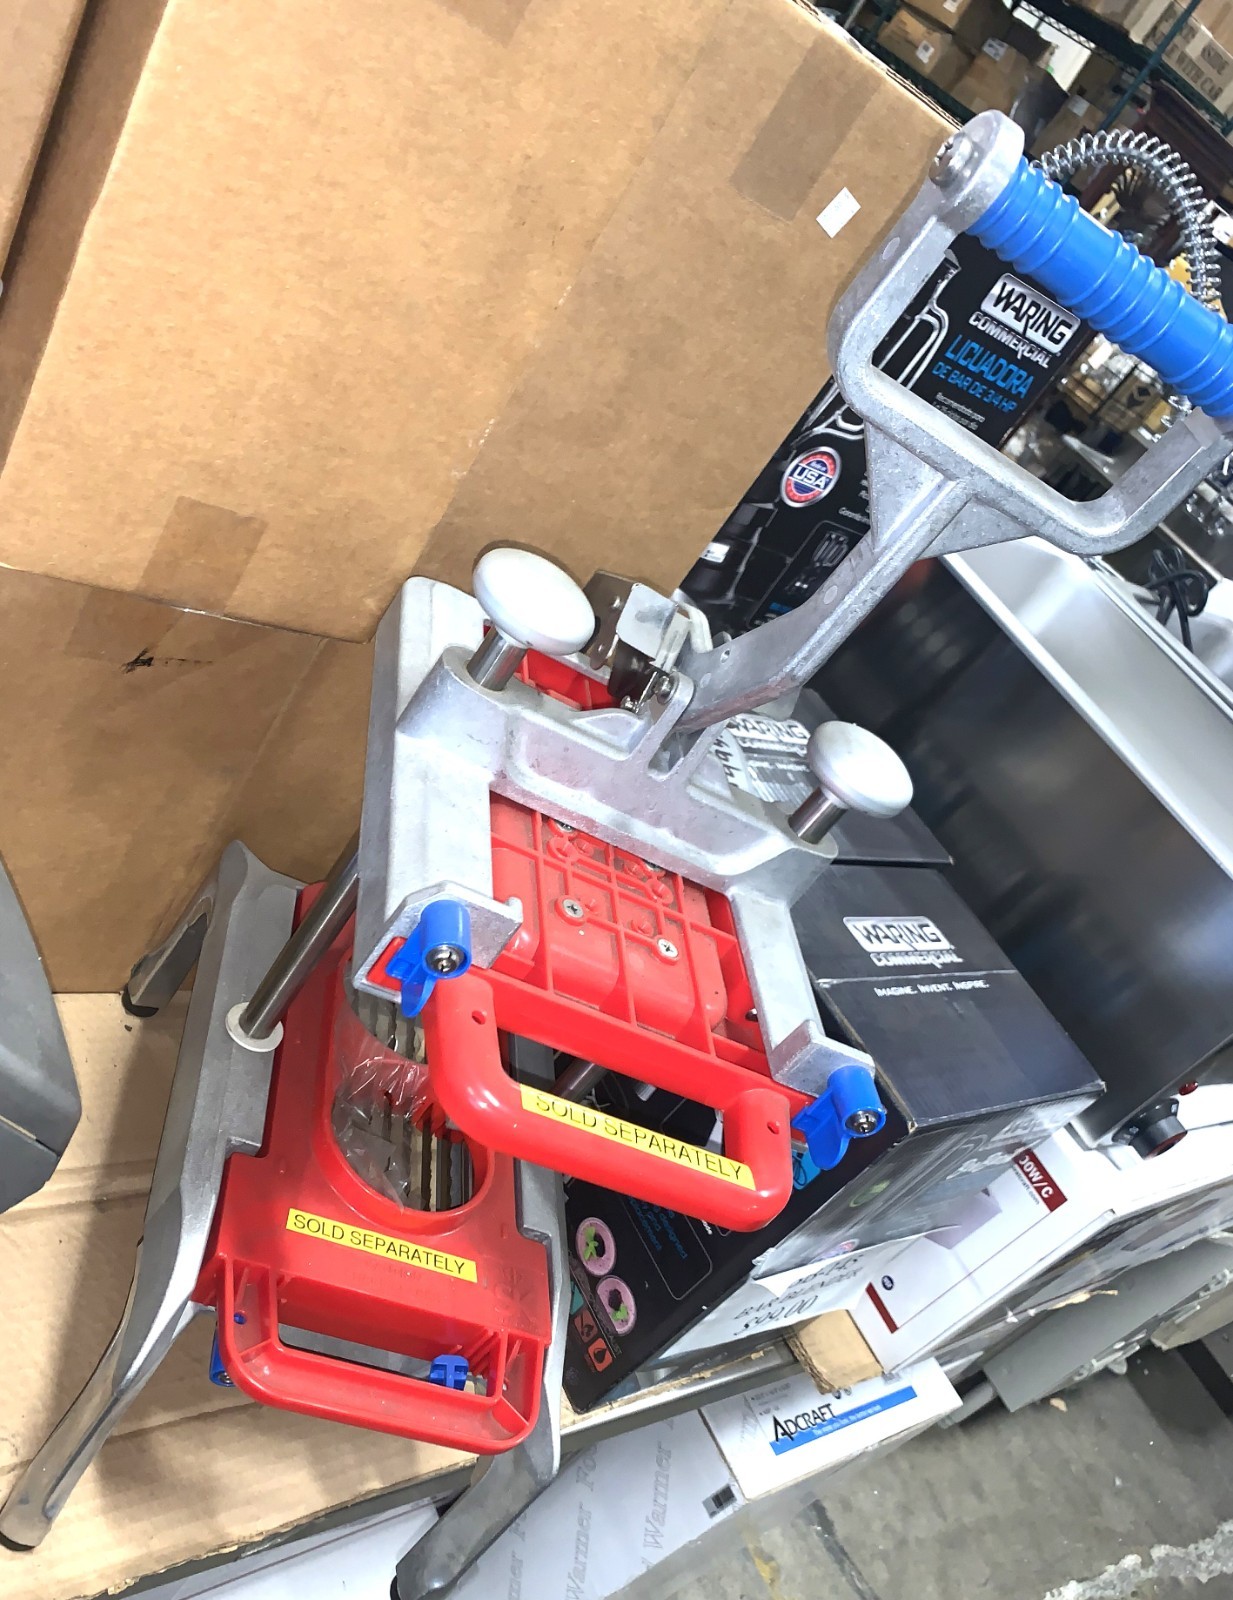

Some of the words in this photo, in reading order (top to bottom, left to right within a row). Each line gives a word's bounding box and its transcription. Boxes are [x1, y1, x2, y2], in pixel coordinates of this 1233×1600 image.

[993, 282, 1073, 346] WARING
[968, 311, 1053, 369] COMMERCIAL
[931, 361, 949, 379] DE
[947, 369, 971, 391] BAR
[968, 381, 988, 398] DE
[944, 334, 1035, 399] LICUADORA
[793, 465, 828, 490] USA
[853, 923, 942, 951] WARING
[870, 950, 964, 969] COMMERCIAL
[536, 1094, 597, 1128] SOLD
[604, 1117, 742, 1180] SEPARATELY
[293, 1213, 345, 1240] SOLD
[350, 1230, 465, 1275] SEPARATELY
[773, 1403, 836, 1442] ADCRAFT
